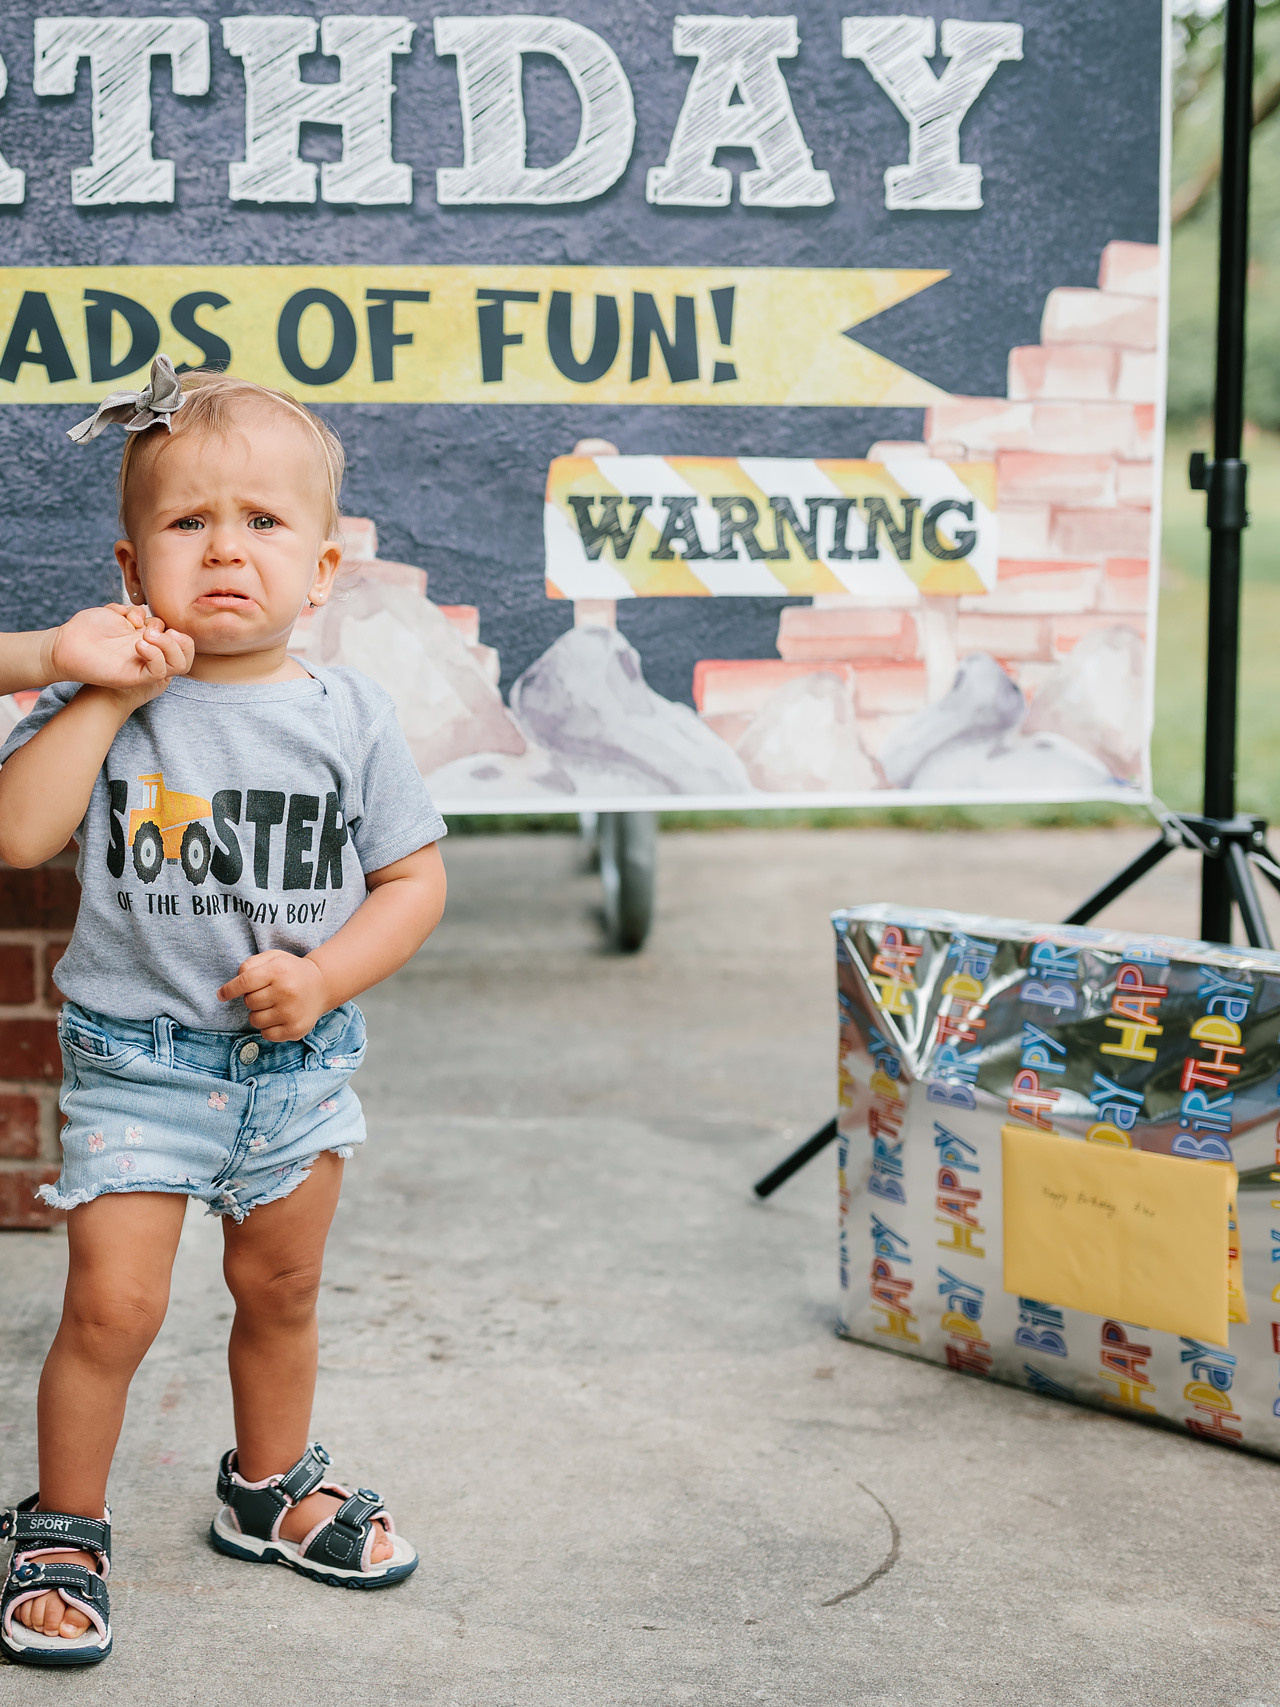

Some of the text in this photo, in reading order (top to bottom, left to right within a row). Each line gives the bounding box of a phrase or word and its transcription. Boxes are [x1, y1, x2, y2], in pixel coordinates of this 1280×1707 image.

[277, 288, 430, 386] OF
[476, 286, 738, 384] FUN!
[568, 496, 977, 560] WARNING
[117, 891, 326, 924] OF THE BIRTHDAY BOY!
[1008, 1021, 1067, 1133] APPY
[29, 1518, 73, 1532] SPORT
